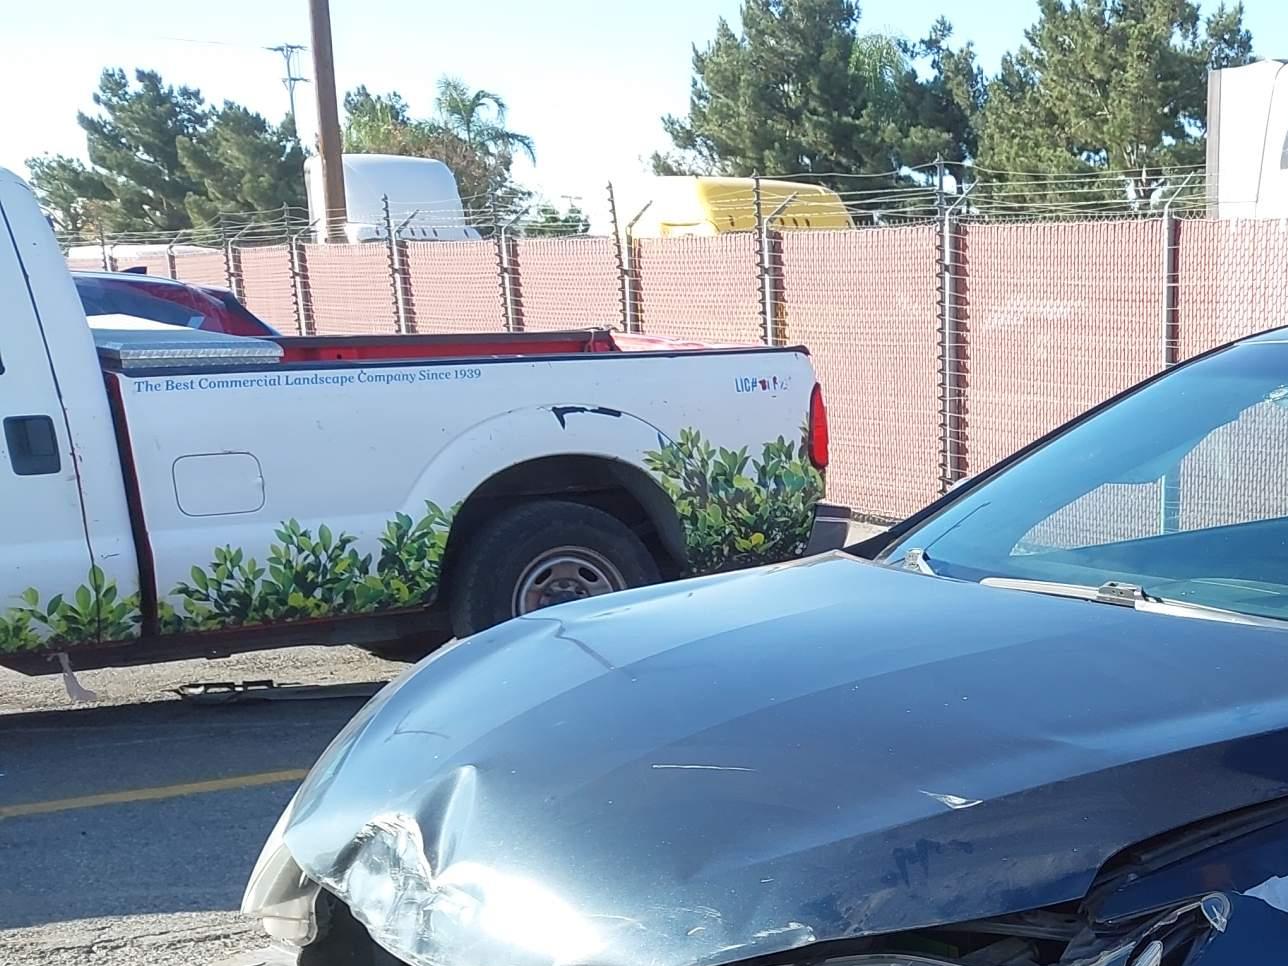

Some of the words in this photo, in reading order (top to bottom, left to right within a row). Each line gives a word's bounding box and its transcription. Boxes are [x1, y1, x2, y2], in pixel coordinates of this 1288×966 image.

[134, 380, 161, 393] The
[165, 378, 195, 391] Best
[198, 375, 281, 390] Commercial
[284, 372, 354, 388] Landscape
[357, 370, 416, 384] Company
[418, 369, 452, 382] Since
[454, 368, 482, 380] 1939
